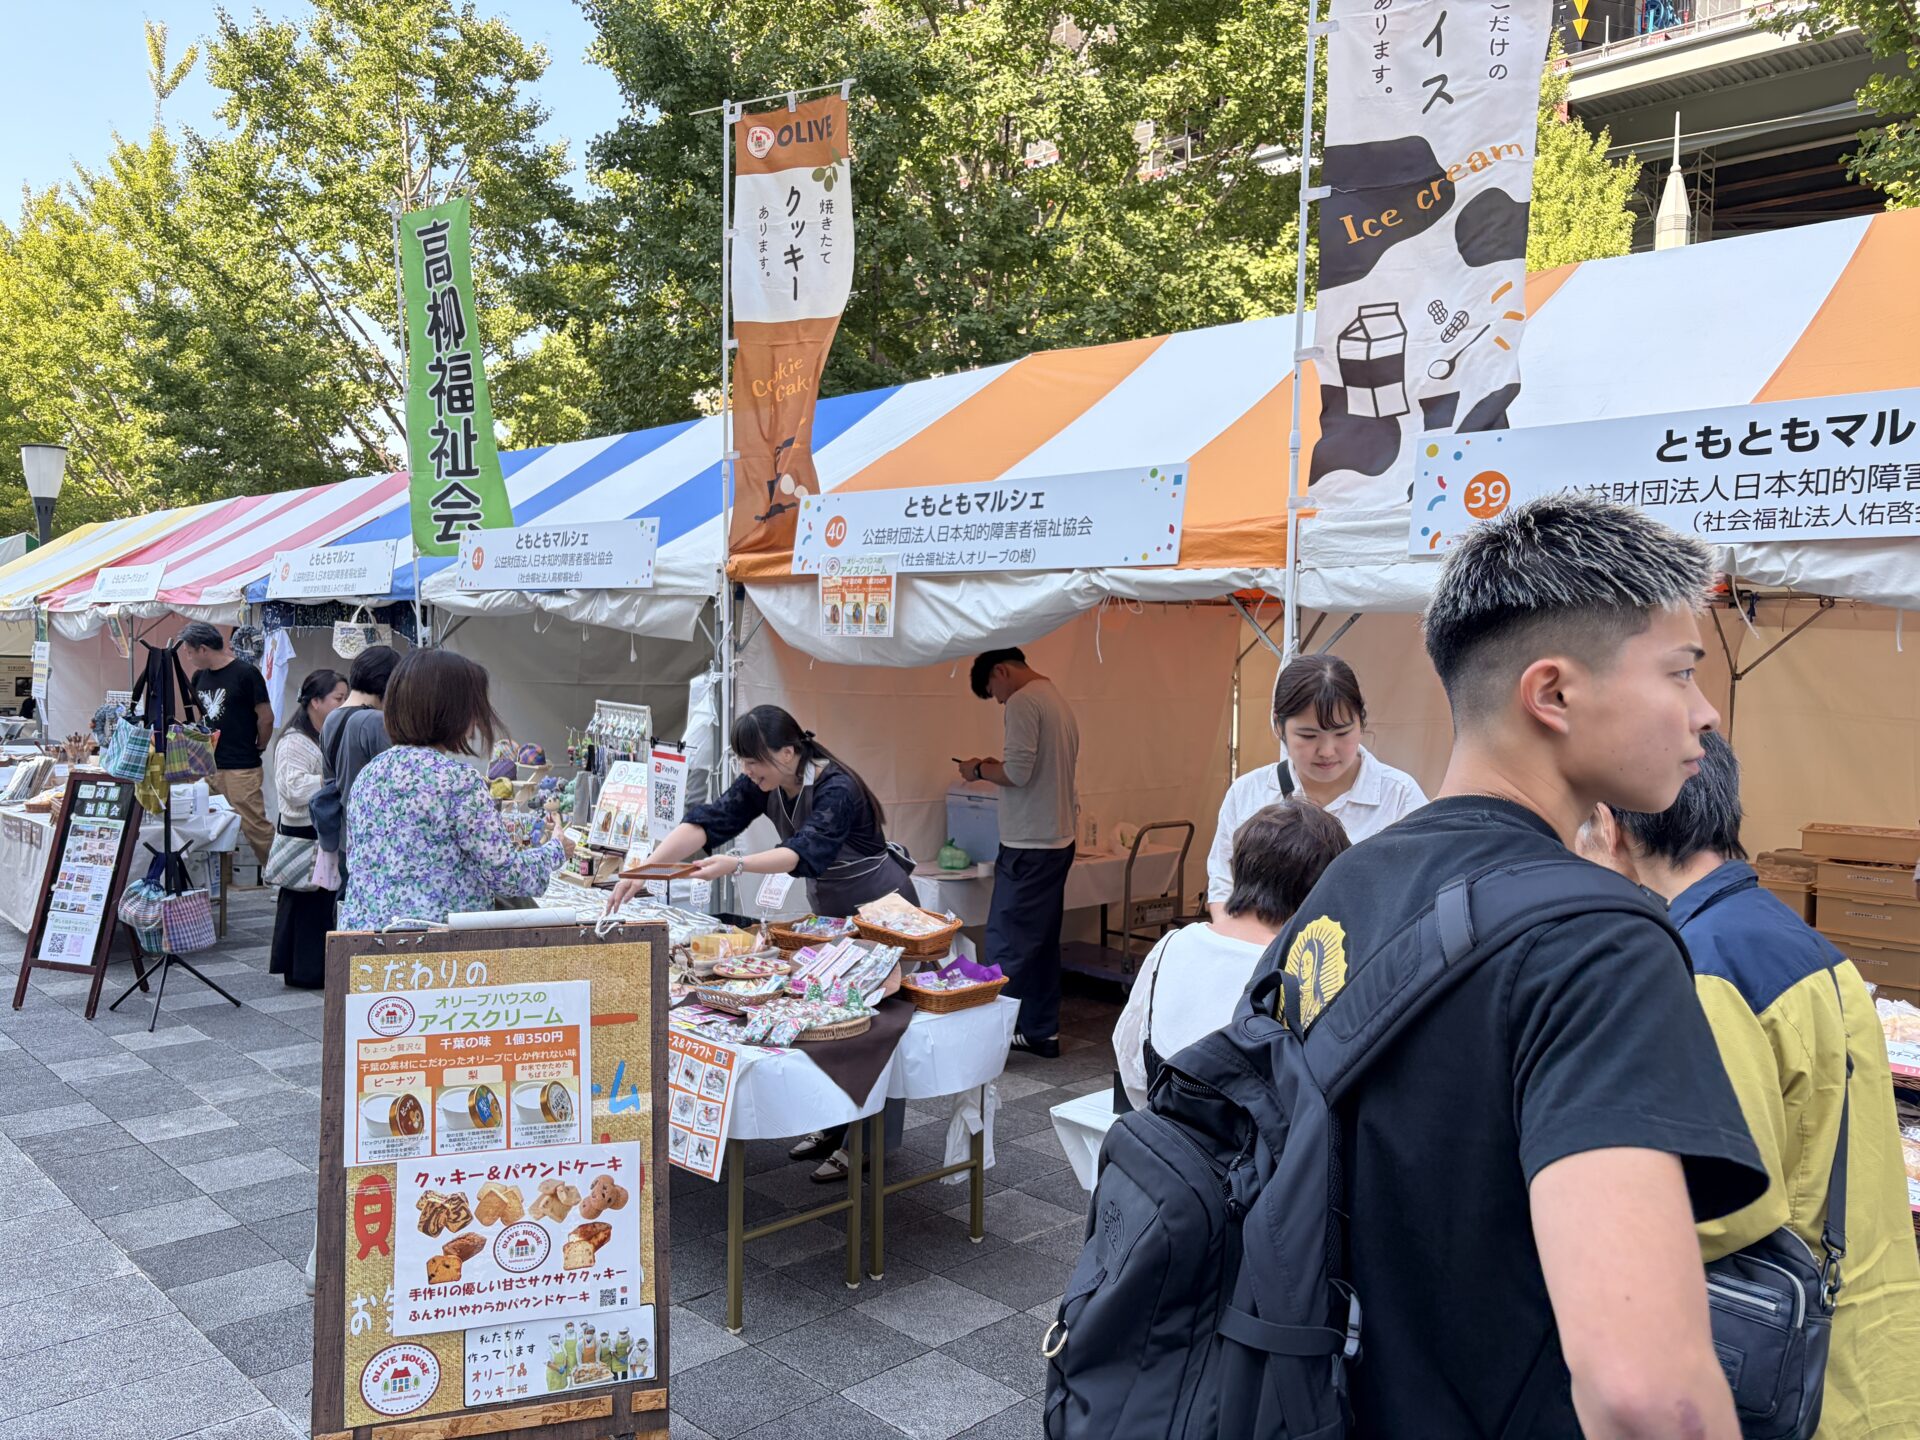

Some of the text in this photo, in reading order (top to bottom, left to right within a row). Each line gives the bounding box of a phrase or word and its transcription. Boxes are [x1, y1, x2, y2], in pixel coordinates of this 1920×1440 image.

[1421, 11, 1455, 114] イス
[777, 115, 832, 147] OLIVE
[1339, 142, 1525, 246] Ice cream
[758, 205, 772, 278] あります。
[783, 185, 804, 301] クッキー
[819, 199, 835, 265] 焼きたて
[416, 218, 483, 543] 高柳福祉会
[776, 375, 812, 402] Cak
[1655, 408, 1917, 463] ともともマル
[903, 488, 1045, 518] ともともマルシェ
[1469, 480, 1506, 510] 39
[826, 521, 846, 541] 40
[862, 515, 1094, 545] 公益財団法人日本知的障害者福祉協会
[1693, 500, 1920, 533] （社会福祉法人佑啓
[515, 530, 589, 550] ともともマルシェ
[309, 550, 356, 567] ともともマルシェ
[473, 552, 484, 565] 41
[358, 958, 487, 992] こだわりの
[435, 991, 547, 1009] オリーブハウスの
[418, 1006, 564, 1033] アイスクリーム
[439, 1030, 564, 1050] 千葉の味 1個350円
[359, 1048, 578, 1073] 千葉の素材にこだわったオリーブにしか作れない味
[467, 1069, 479, 1081] 梨
[520, 1060, 569, 1072] お米でかためた
[373, 1075, 417, 1088] ピーナツ
[414, 1155, 623, 1188] クッキー&パウンドケーキ
[501, 1229, 543, 1249] OLIVE HOUSE
[408, 1266, 628, 1302] 手作りの優しい甘さサクサククッキー
[408, 1290, 591, 1322] ふんわりやわらかパウンドケーキ
[479, 1328, 526, 1344] 私たちが
[372, 1353, 430, 1383] OLIVE HOUSE
[467, 1343, 536, 1364] 作っています
